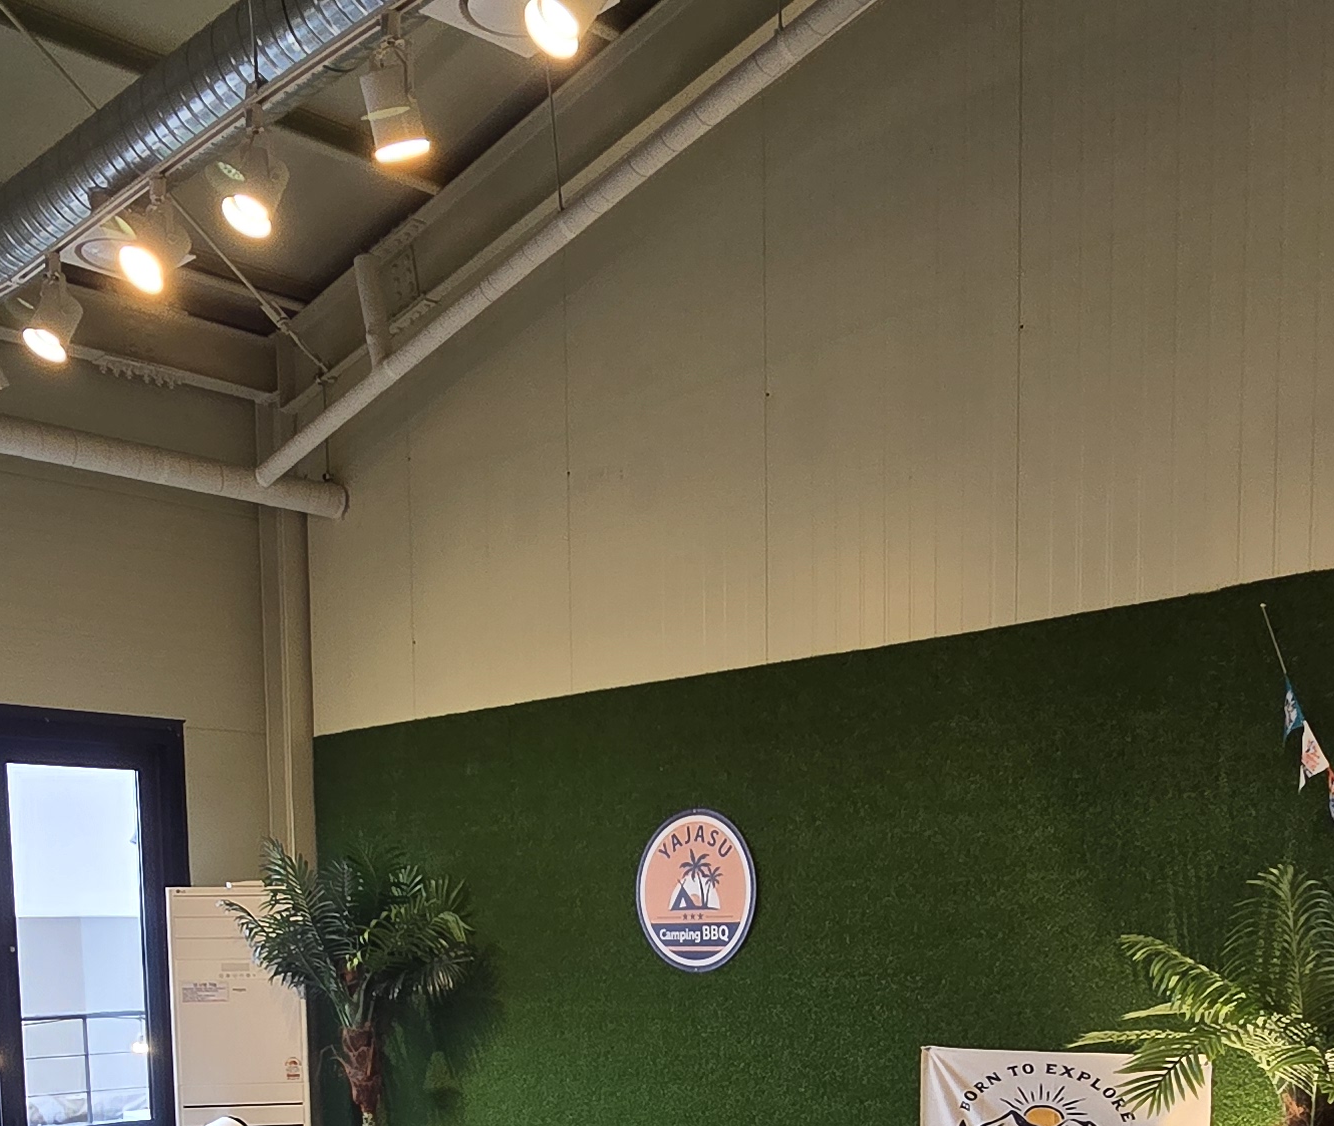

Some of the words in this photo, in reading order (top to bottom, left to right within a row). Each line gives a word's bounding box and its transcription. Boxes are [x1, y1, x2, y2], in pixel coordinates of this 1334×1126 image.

[658, 825, 733, 859] YAJASU
[659, 928, 701, 943] Camping
[702, 925, 729, 941] BBQ
[959, 1071, 1002, 1112] BORN
[1007, 1063, 1035, 1077] TO
[1045, 1063, 1136, 1123] EXPLORE
